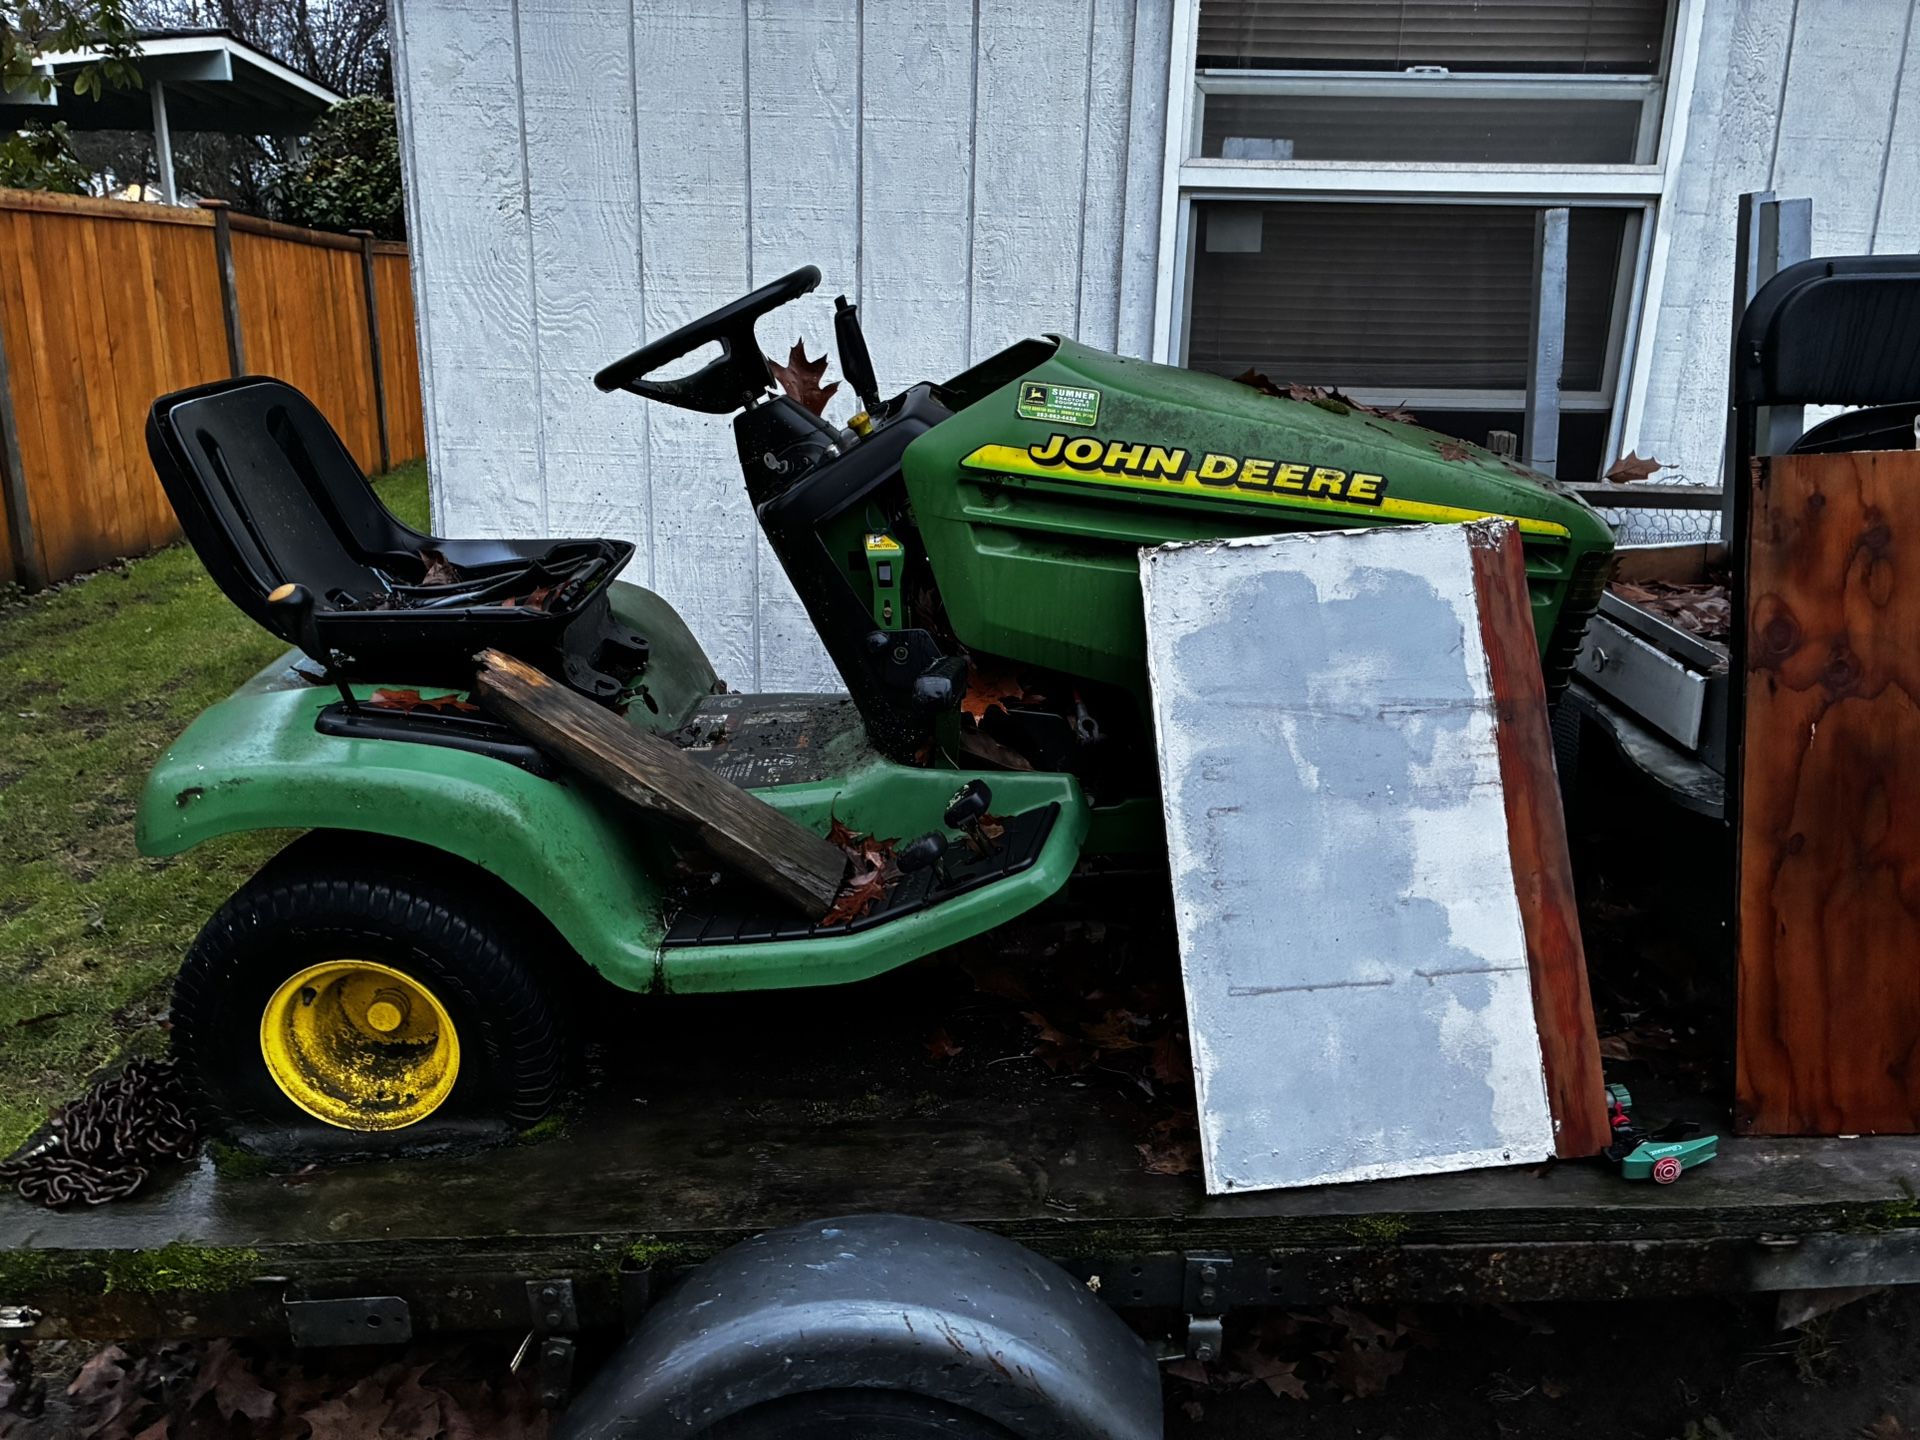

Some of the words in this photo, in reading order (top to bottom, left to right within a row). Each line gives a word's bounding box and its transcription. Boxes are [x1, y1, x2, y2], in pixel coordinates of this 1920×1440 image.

[1051, 388, 1095, 400] SUMNER
[1054, 400, 1090, 408] EQUIPMENT
[1029, 433, 1190, 480] JOHN
[1197, 452, 1387, 505] DEERE
